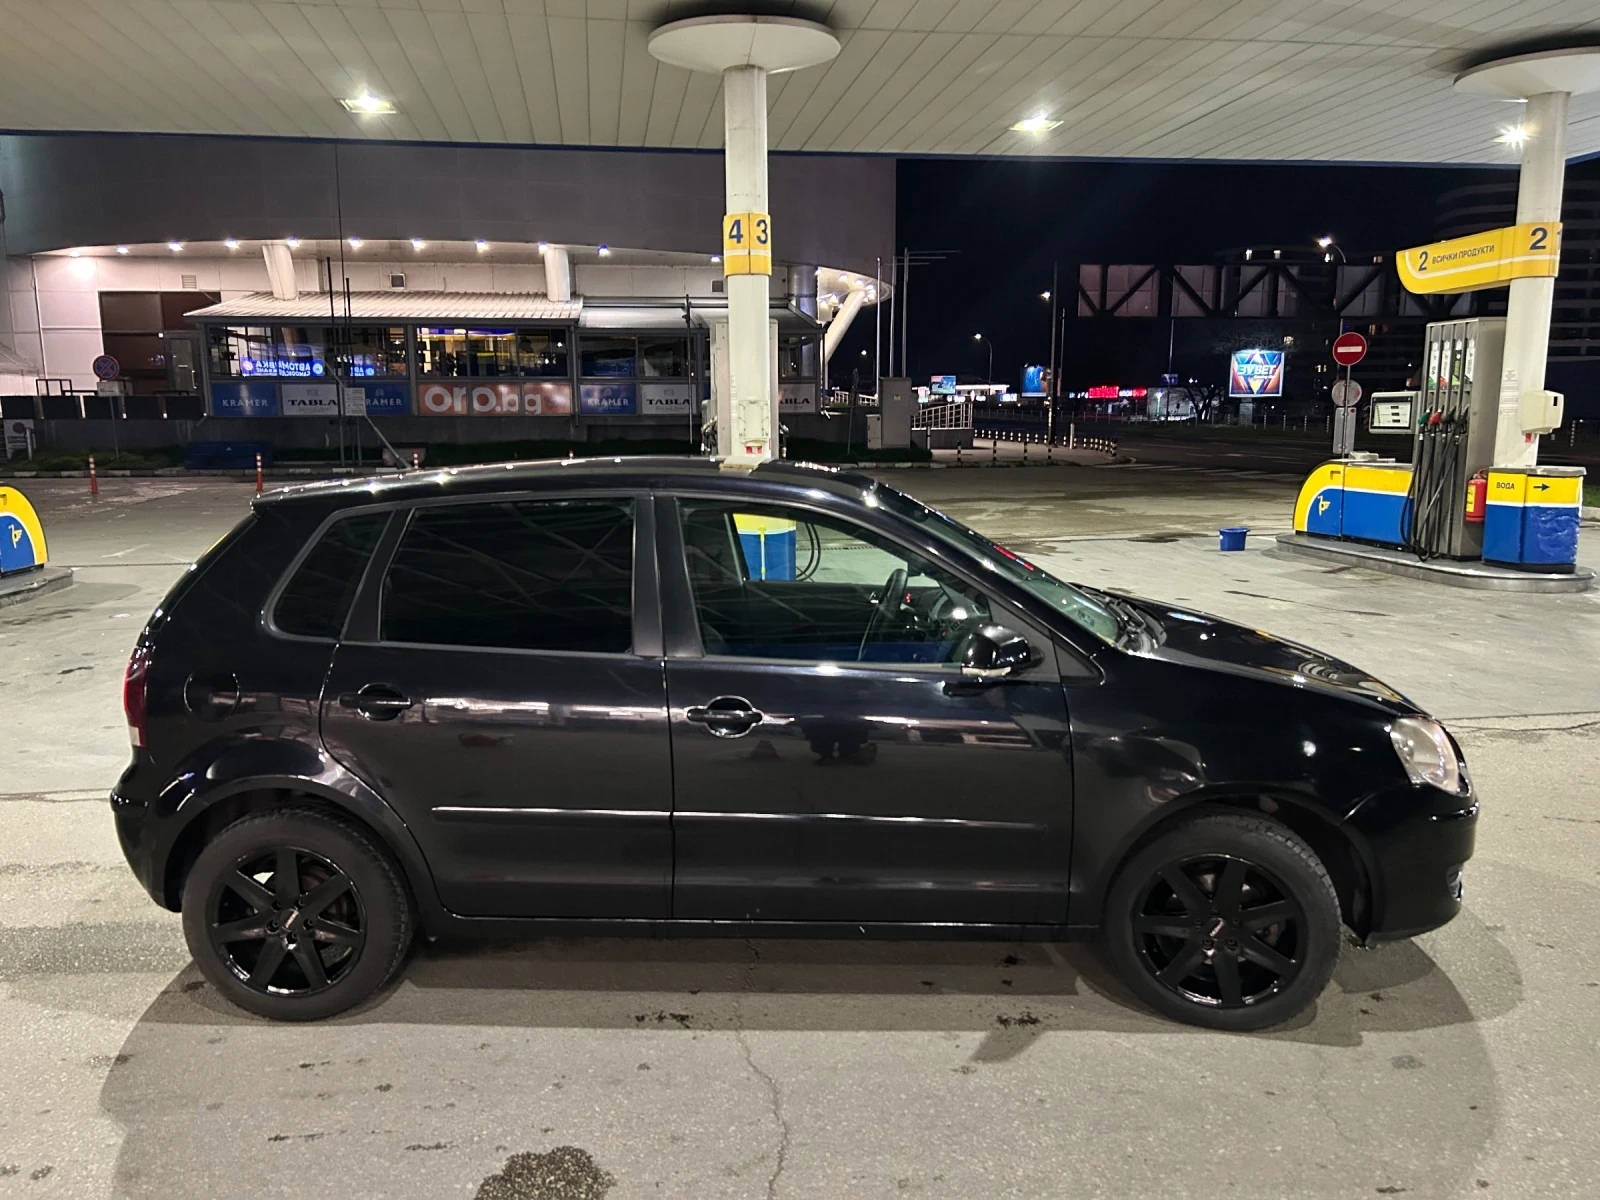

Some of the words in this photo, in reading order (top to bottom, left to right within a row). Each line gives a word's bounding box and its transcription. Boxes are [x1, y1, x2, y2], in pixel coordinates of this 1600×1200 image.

[729, 219, 743, 244] 4
[756, 219, 768, 245] 3
[1529, 227, 1548, 250] 2
[1418, 250, 1429, 271] 2
[1432, 252, 1458, 265] ВСИЧКИ
[1458, 244, 1495, 259] ПРОДУКТИ
[366, 398, 402, 406] RAMER
